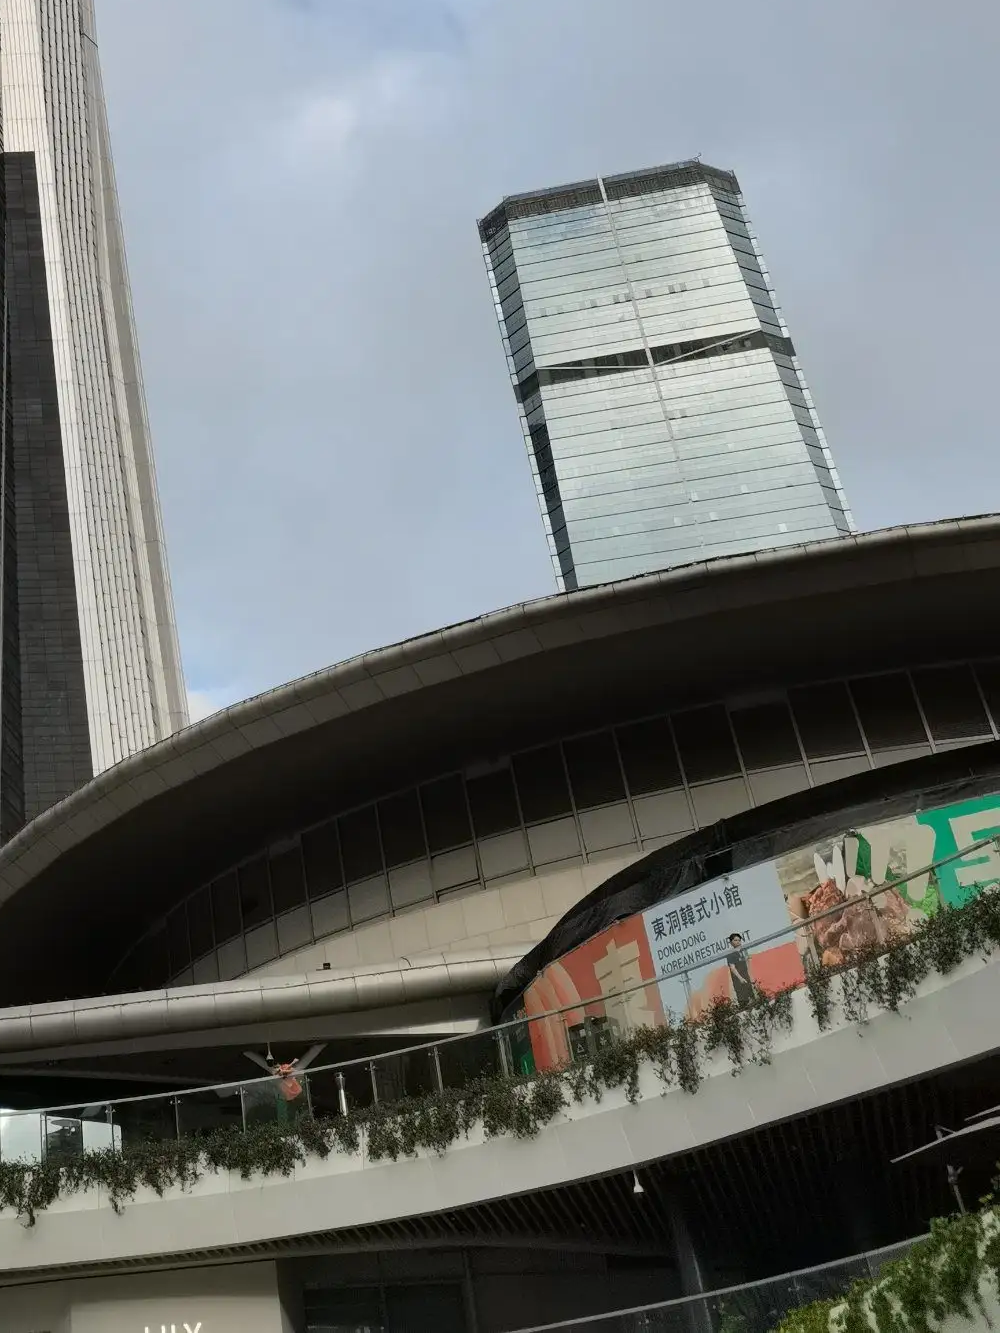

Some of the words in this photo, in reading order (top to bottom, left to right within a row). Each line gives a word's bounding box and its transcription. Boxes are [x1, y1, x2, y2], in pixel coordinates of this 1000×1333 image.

[651, 884, 742, 941] 東洞韓式小館
[657, 941, 682, 960] DONG
[681, 931, 706, 950] DONG
[661, 952, 697, 975] KOREAN
[695, 930, 751, 961] RESTAURNT
